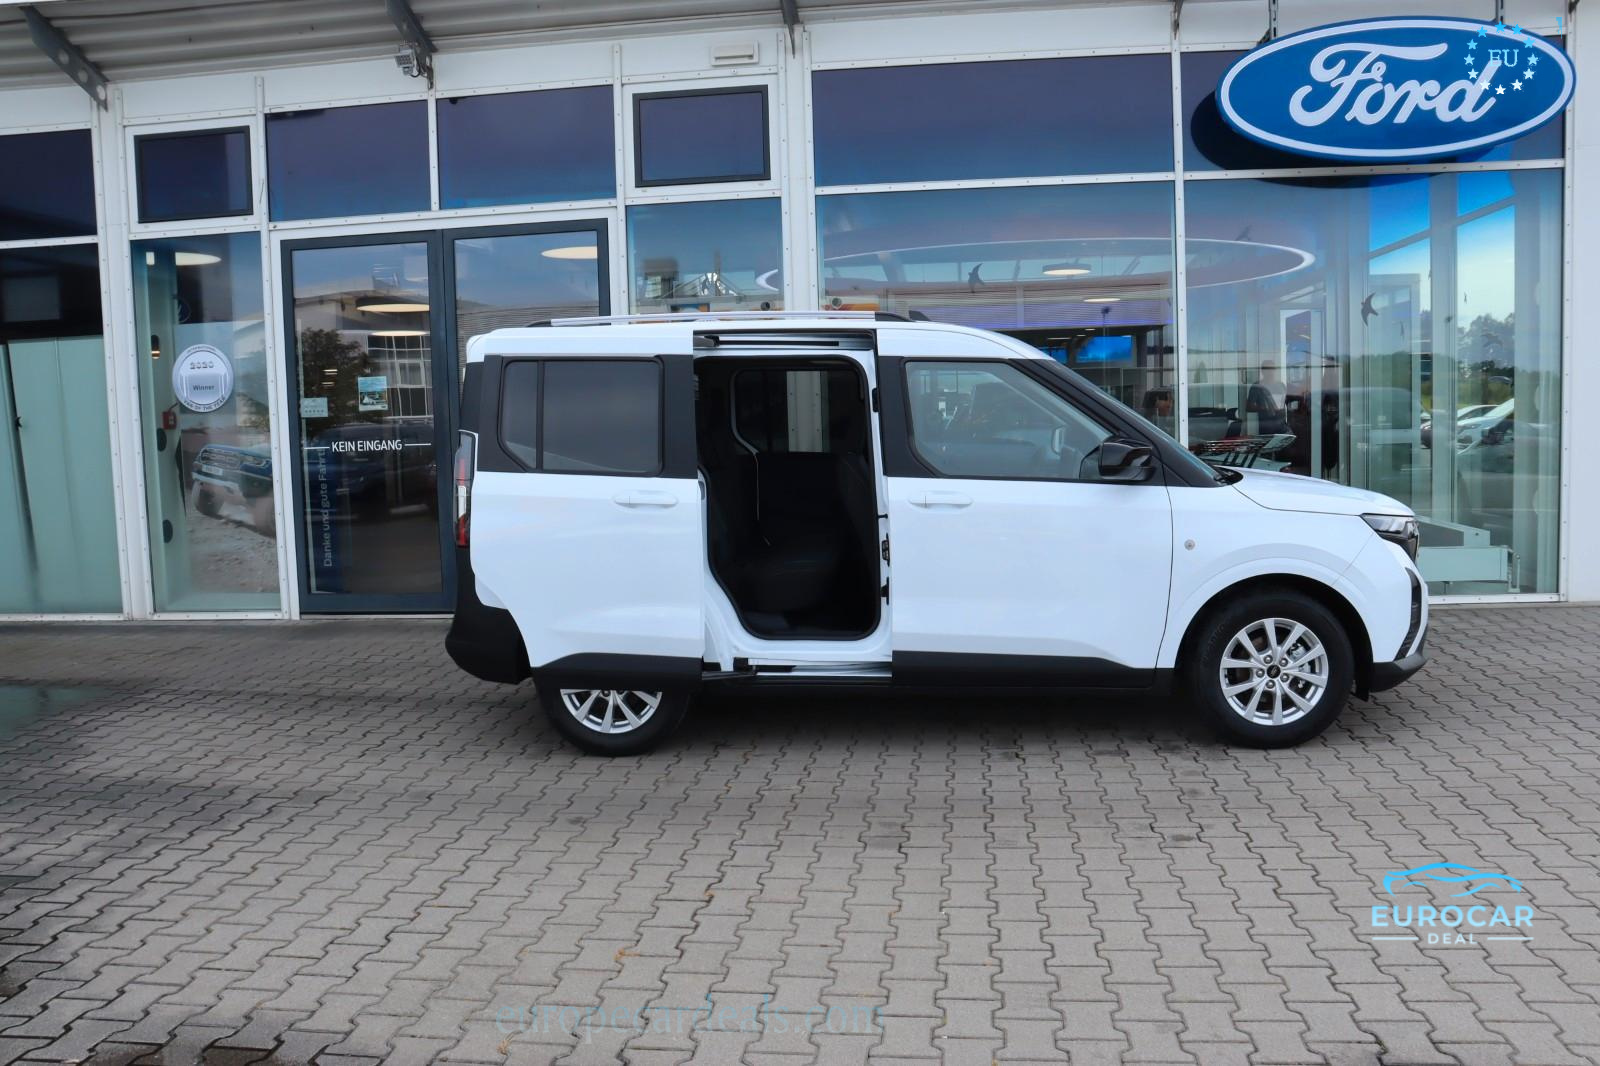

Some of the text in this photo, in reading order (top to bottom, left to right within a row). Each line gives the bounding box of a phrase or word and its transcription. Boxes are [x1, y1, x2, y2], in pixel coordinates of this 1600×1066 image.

[1289, 42, 1501, 127] Ford
[331, 439, 402, 452] KEIN EINGANG
[320, 483, 330, 508] gute
[321, 509, 330, 531] und
[323, 532, 332, 567] Danke
